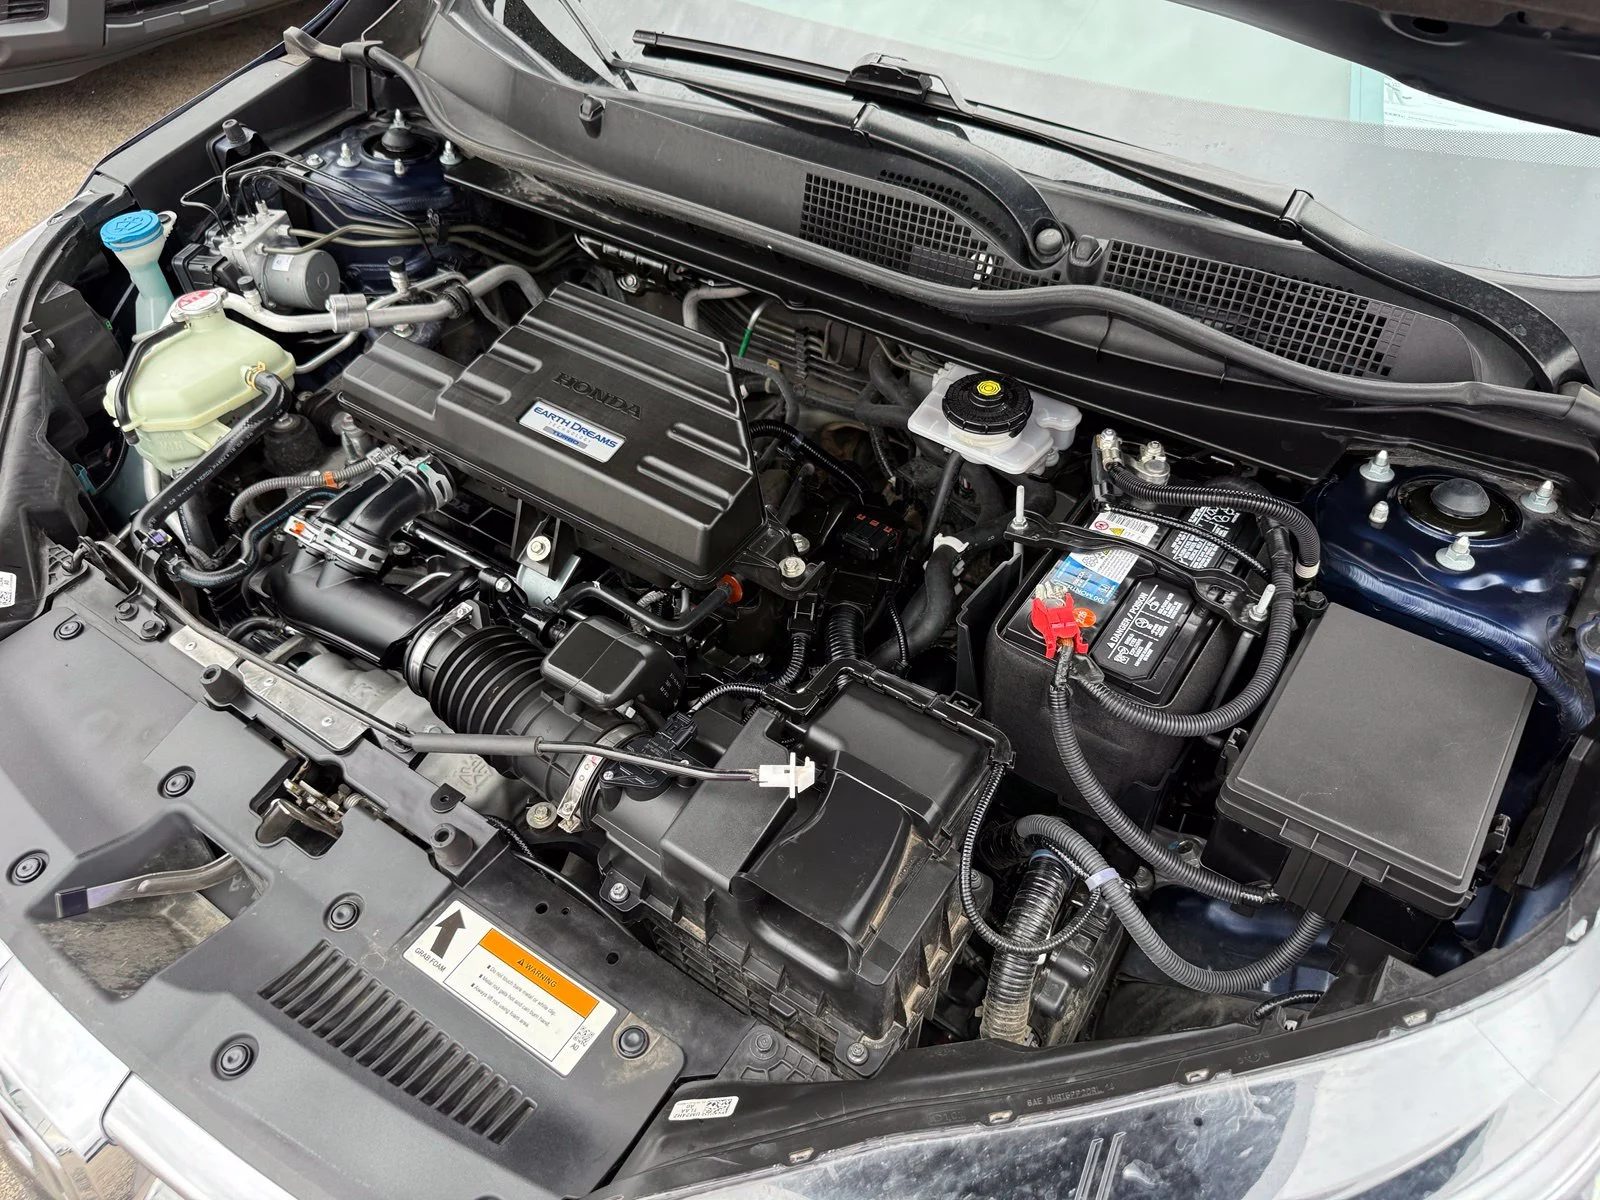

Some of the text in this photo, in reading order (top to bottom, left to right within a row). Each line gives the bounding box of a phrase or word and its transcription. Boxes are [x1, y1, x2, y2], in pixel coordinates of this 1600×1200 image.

[552, 372, 642, 420] HONDA
[533, 406, 618, 448] EARTH DREAMS
[552, 430, 580, 446] TURBO
[1091, 594, 1106, 605] 100
[1110, 617, 1131, 643] DANGER
[1130, 592, 1149, 615] POISON
[414, 947, 447, 973] GRAB FOAM
[525, 962, 558, 988] WARNING
